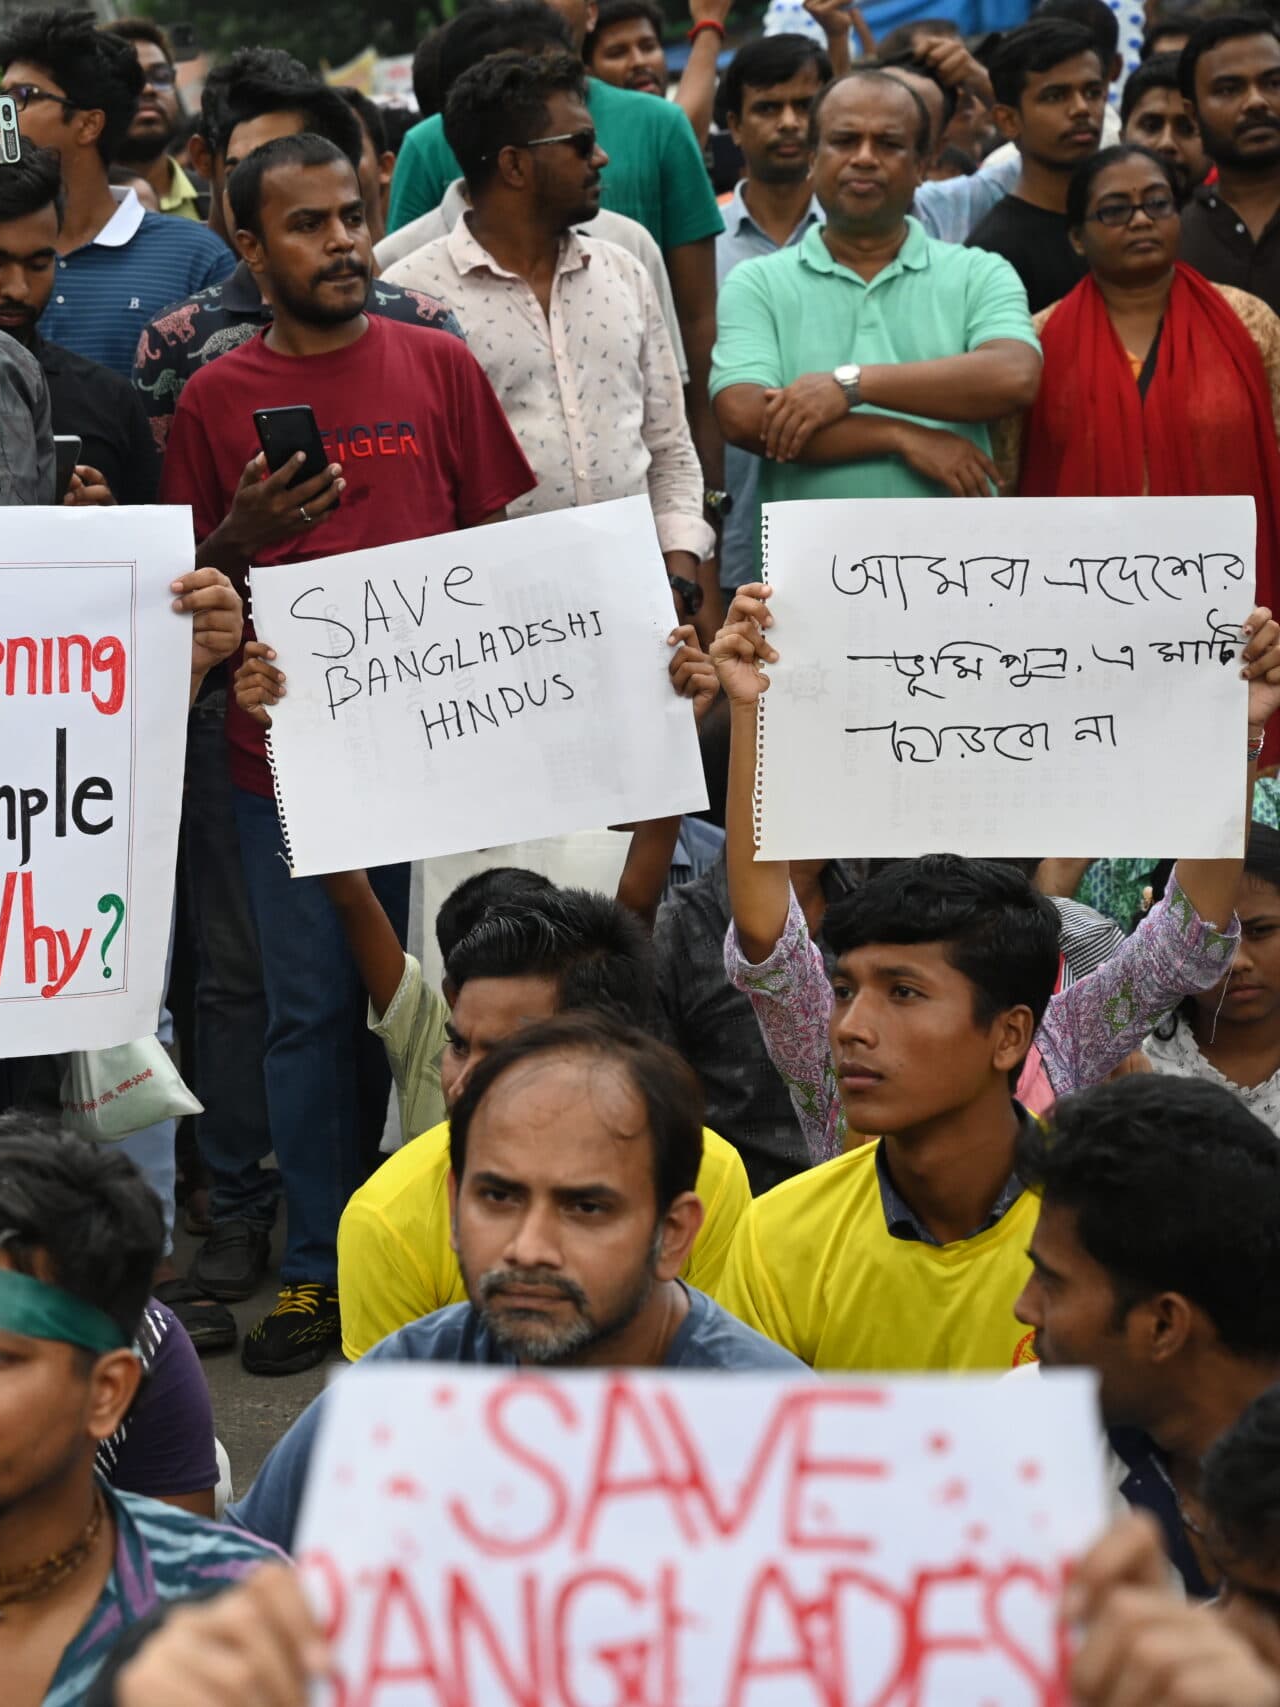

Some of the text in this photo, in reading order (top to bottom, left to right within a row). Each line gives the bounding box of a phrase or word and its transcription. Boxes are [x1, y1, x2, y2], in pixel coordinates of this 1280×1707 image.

[325, 611, 605, 720] BANGLADESHI
[421, 674, 575, 750] HINDUS
[447, 1369, 890, 1558] SAVE
